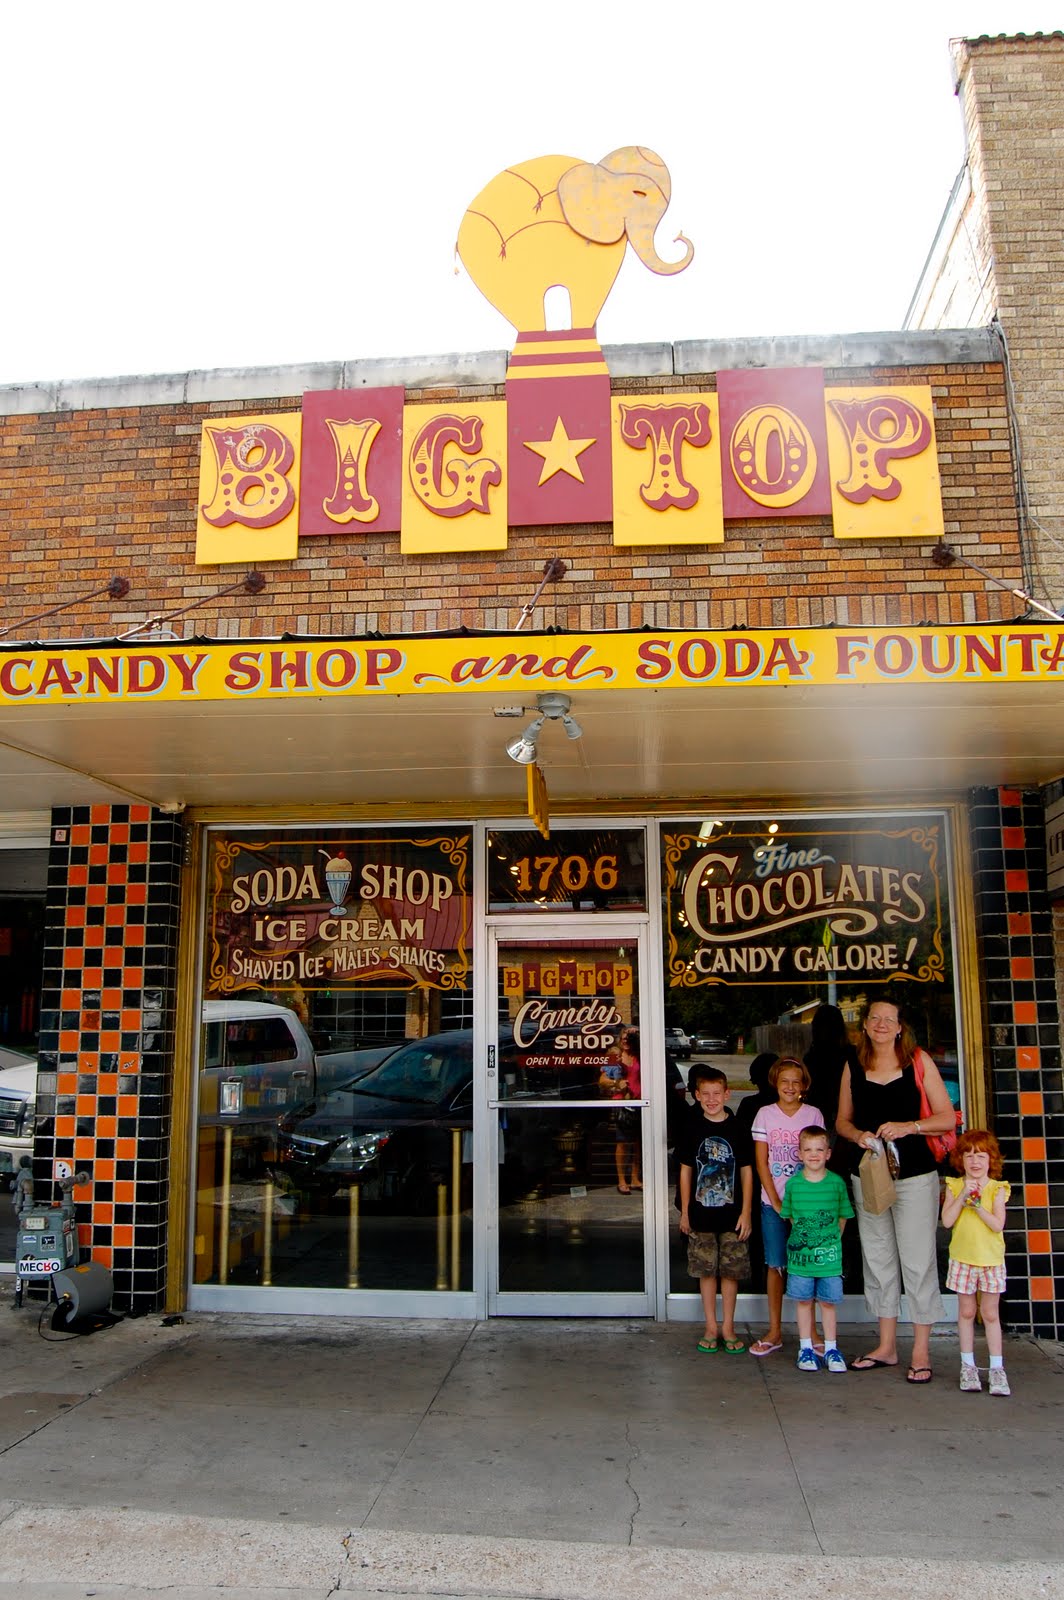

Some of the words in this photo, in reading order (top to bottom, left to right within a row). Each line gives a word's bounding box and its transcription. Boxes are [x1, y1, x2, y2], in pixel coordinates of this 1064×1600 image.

[201, 412, 501, 530] BIG
[617, 395, 932, 513] TOP
[1, 652, 208, 697] CANDY
[224, 648, 407, 692] SHOP
[430, 645, 617, 687] and
[635, 638, 814, 682] SODA
[516, 855, 619, 891] 1706
[753, 842, 836, 878] Fine
[230, 864, 321, 914] SODA
[359, 863, 454, 912] SHOP
[684, 853, 926, 943] CHOCOLATES
[254, 919, 308, 942] ICE
[318, 918, 425, 942] CREAM
[231, 949, 295, 981] SHAVED
[299, 952, 325, 979] ICE
[333, 947, 381, 973] MALTS
[388, 946, 446, 974] SHAKES
[694, 946, 786, 974] CANDY
[505, 970, 558, 990] BIG
[578, 967, 630, 987] TOP
[513, 999, 622, 1048] Candy
[554, 1034, 615, 1050] SHOP
[525, 1057, 550, 1066] OPEN
[552, 1055, 566, 1065] 'TIL
[568, 1056, 582, 1065] WE
[584, 1055, 609, 1065] CLOSE
